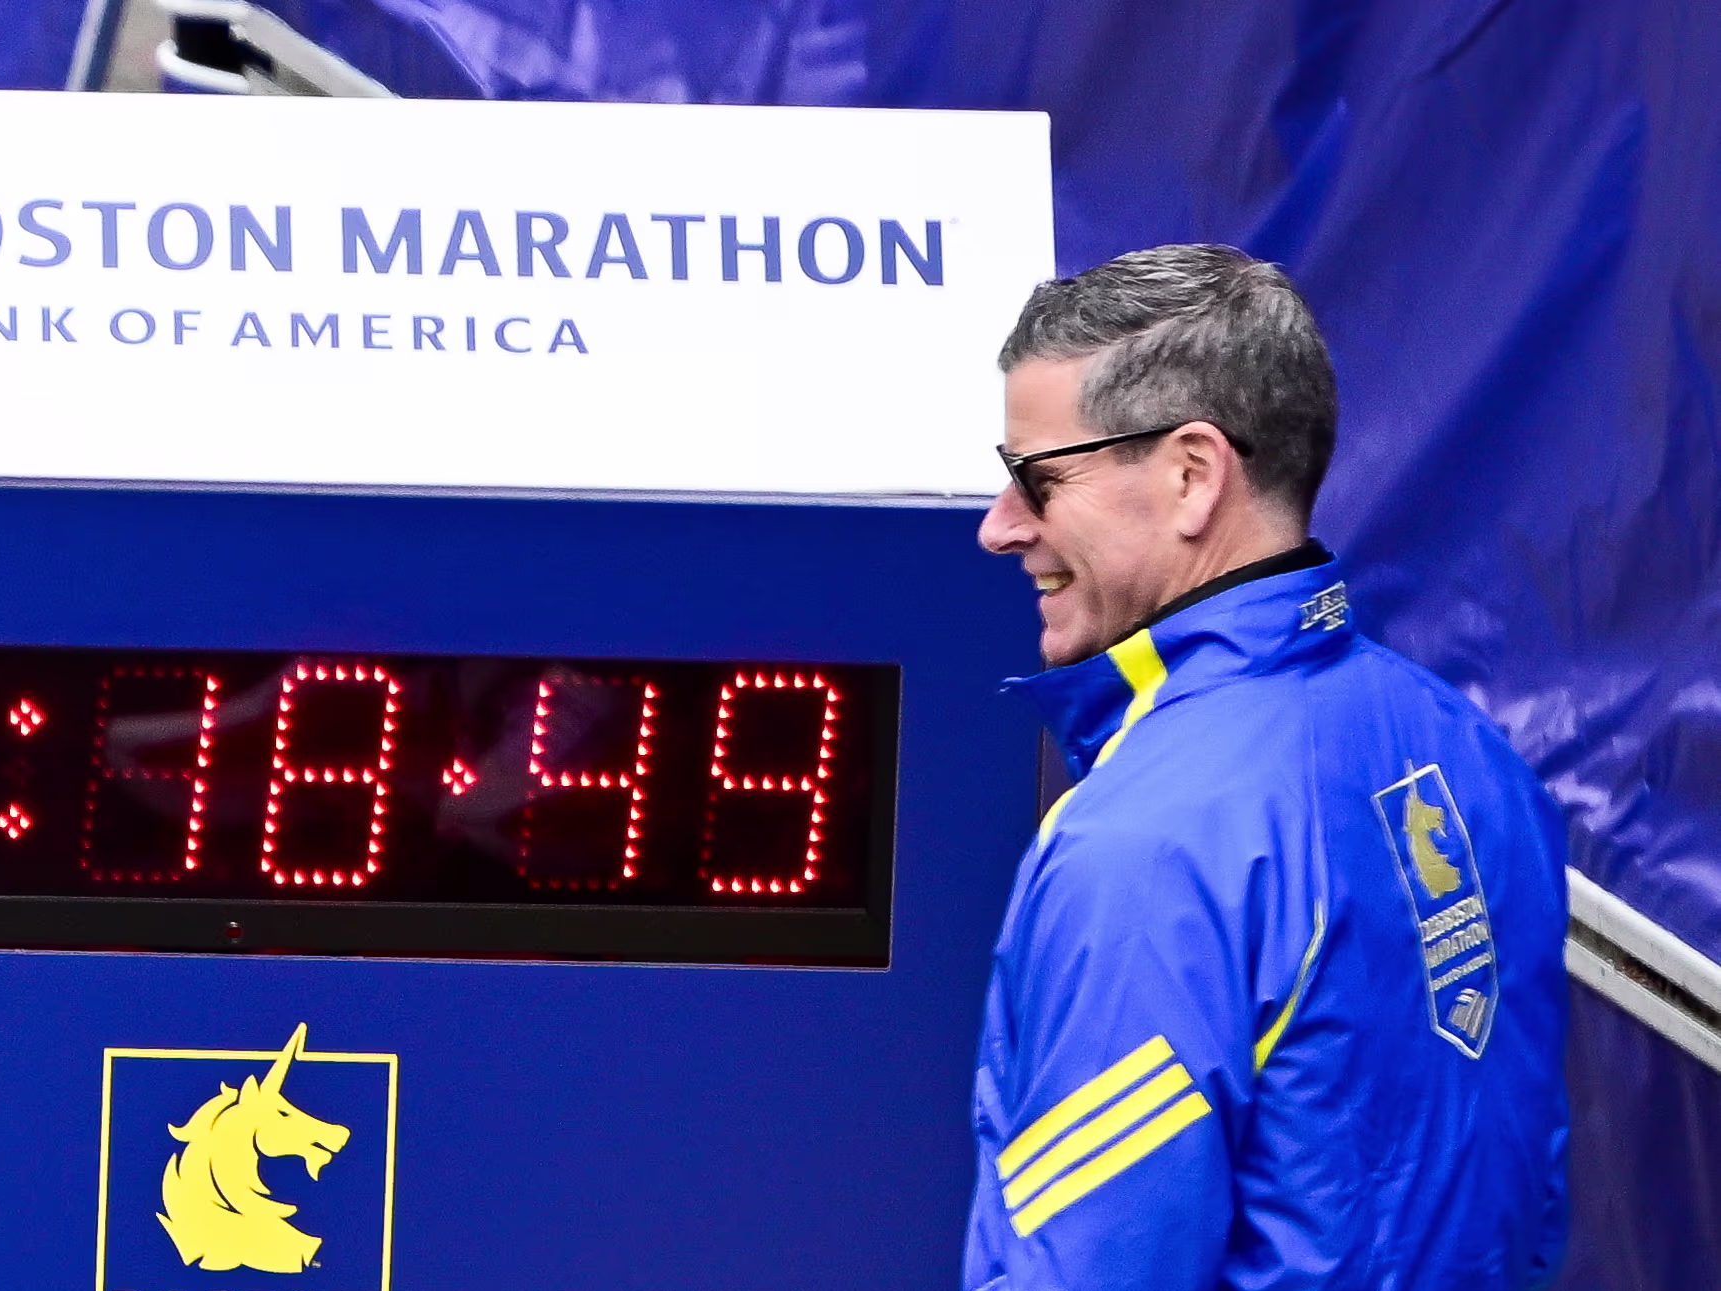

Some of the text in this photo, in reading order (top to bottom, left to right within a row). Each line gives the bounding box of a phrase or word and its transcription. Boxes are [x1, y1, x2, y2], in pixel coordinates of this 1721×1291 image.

[342, 208, 943, 286] MARATHON
[110, 309, 200, 344] OF
[231, 312, 588, 354] AMERICA
